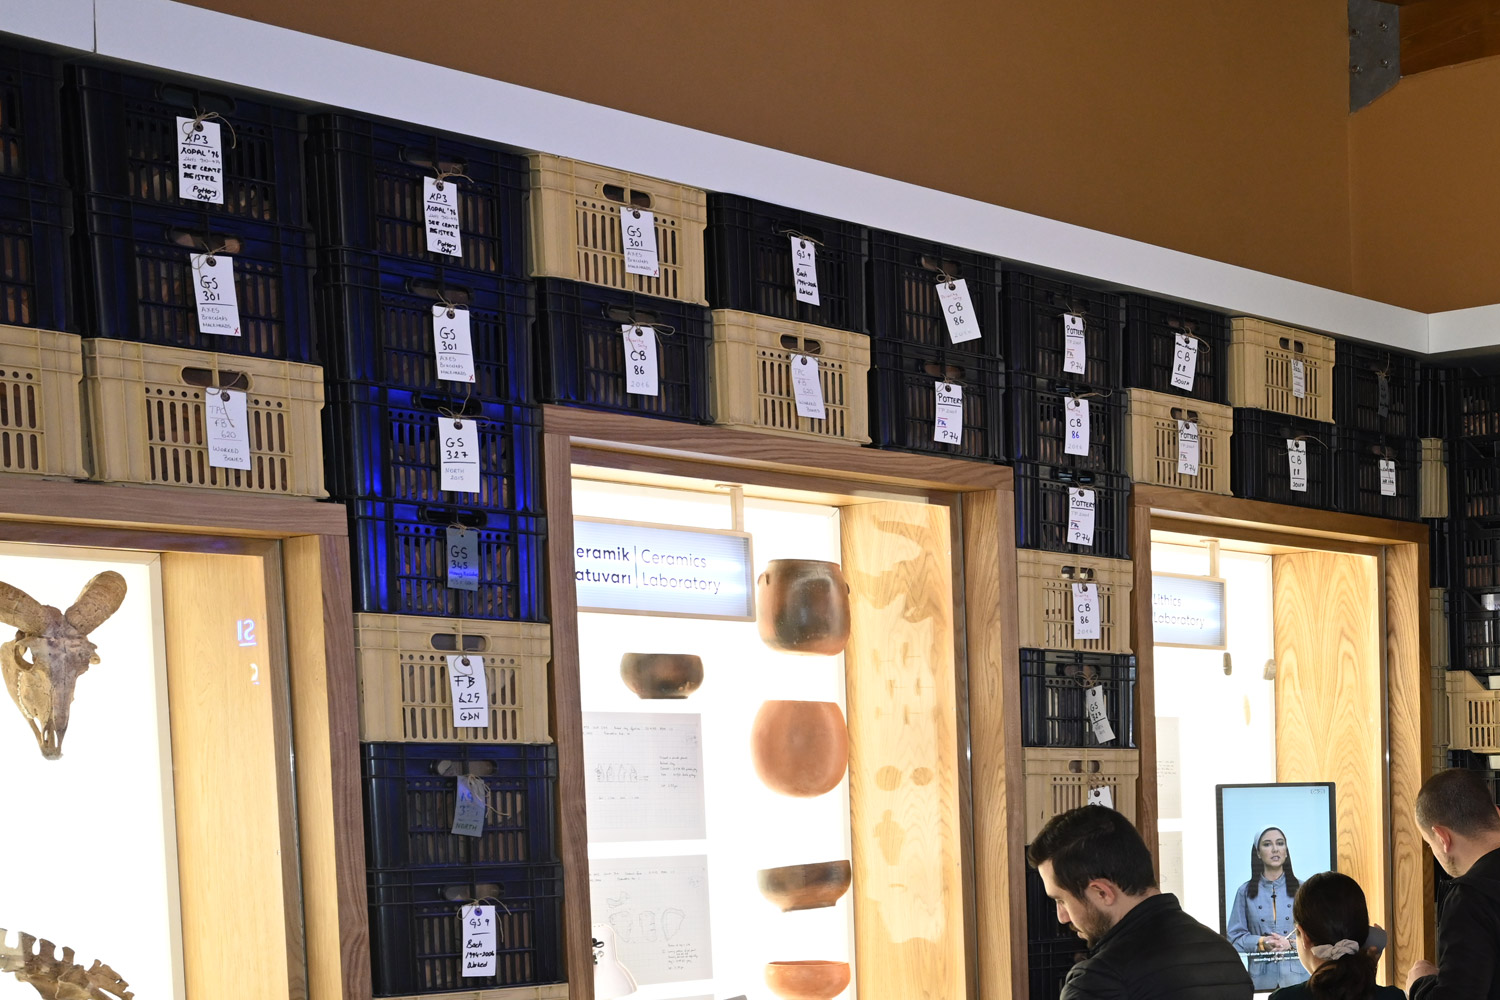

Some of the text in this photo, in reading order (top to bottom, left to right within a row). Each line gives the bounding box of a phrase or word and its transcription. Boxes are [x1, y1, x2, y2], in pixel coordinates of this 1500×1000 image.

[183, 163, 197, 171] SEE
[627, 225, 642, 238] GS
[629, 238, 643, 247] 301
[200, 275, 218, 290] GS
[202, 290, 220, 301] 301
[953, 316, 965, 326] 86
[440, 327, 456, 340] GS
[442, 341, 457, 351] 301
[634, 364, 645, 376] 86
[1071, 430, 1080, 439] 86
[446, 437, 464, 448] GS
[446, 450, 468, 460] 327
[451, 545, 467, 559] GS
[641, 549, 706, 568] Ceramics
[451, 560, 468, 570] 345
[643, 571, 720, 594] Laboratory
[1154, 593, 1181, 607] Lithics
[1080, 615, 1089, 624] 86
[1154, 611, 1204, 629] Laboratory
[453, 675, 476, 689] FB
[460, 711, 480, 721] GDN
